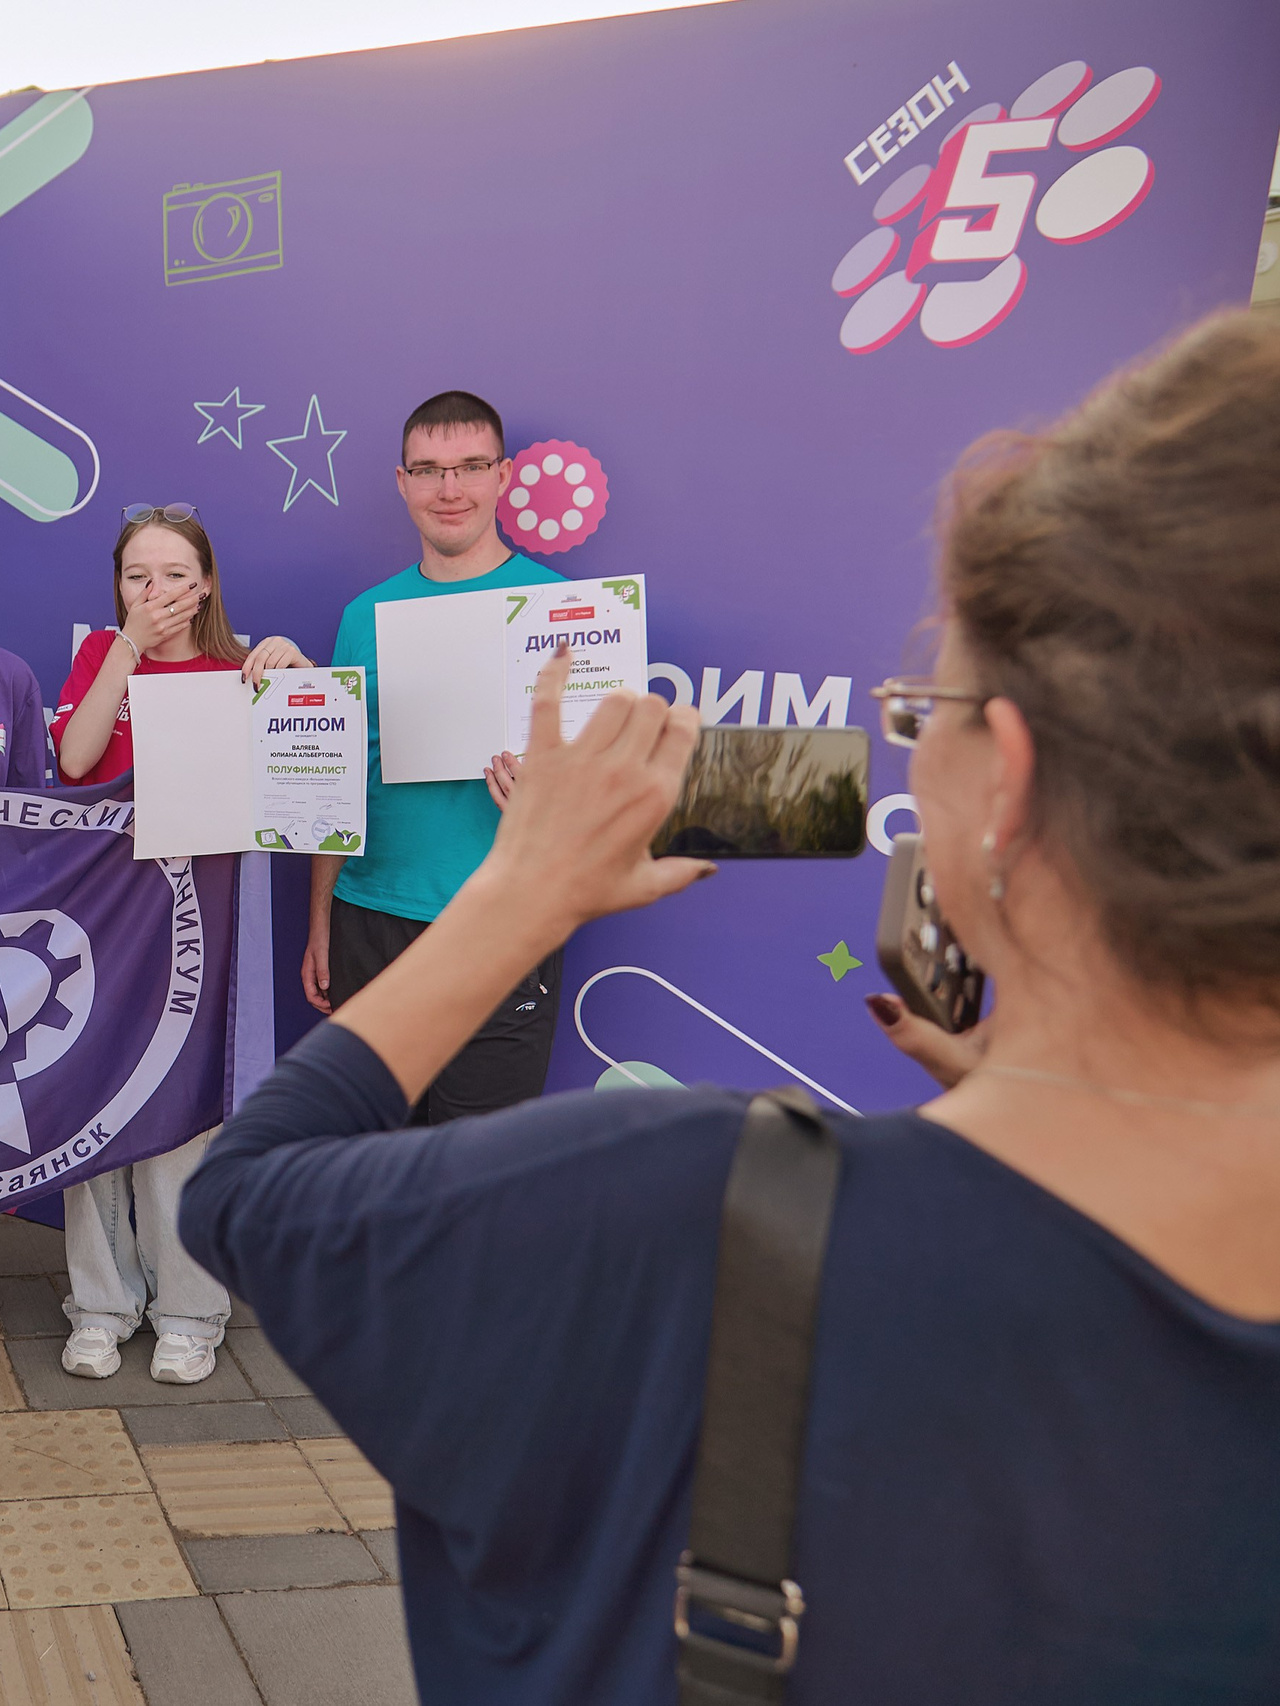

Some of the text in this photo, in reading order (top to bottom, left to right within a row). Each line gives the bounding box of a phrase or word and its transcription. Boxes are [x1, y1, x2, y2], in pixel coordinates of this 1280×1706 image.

[843, 60, 971, 186] СЕЗОН
[923, 114, 1059, 264] 5
[525, 628, 621, 653] ДИПЛОМ
[525, 679, 625, 694] ПОИНАЛИСТ
[267, 717, 345, 734] ДИПЛОМ
[267, 765, 347, 774] ПОЛУФИНАЛИСТ
[159, 856, 201, 1016] ХНИКУМ
